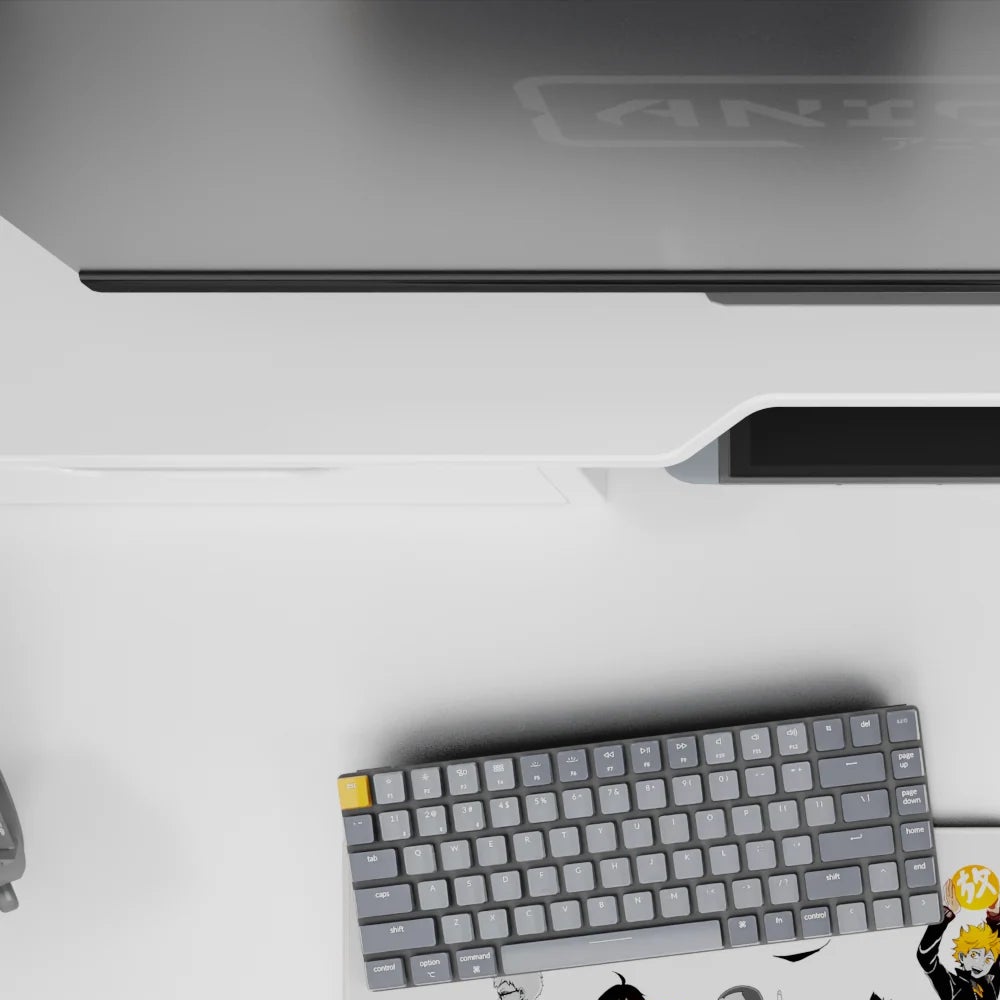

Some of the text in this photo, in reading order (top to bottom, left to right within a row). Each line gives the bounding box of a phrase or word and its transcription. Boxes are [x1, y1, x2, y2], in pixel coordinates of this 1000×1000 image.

[860, 720, 870, 728] del
[898, 751, 914, 760] page
[900, 761, 908, 769] up
[902, 788, 917, 797] page
[902, 796, 922, 805] down
[906, 826, 924, 834] home
[913, 862, 926, 870] end
[826, 873, 840, 881] shift
[957, 867, 997, 904] 放
[375, 891, 390, 899] caps
[775, 916, 782, 924] fn
[804, 911, 826, 921] control
[389, 925, 404, 934] shift
[459, 952, 491, 962] command
[419, 958, 441, 967] option
[373, 963, 396, 973] control
